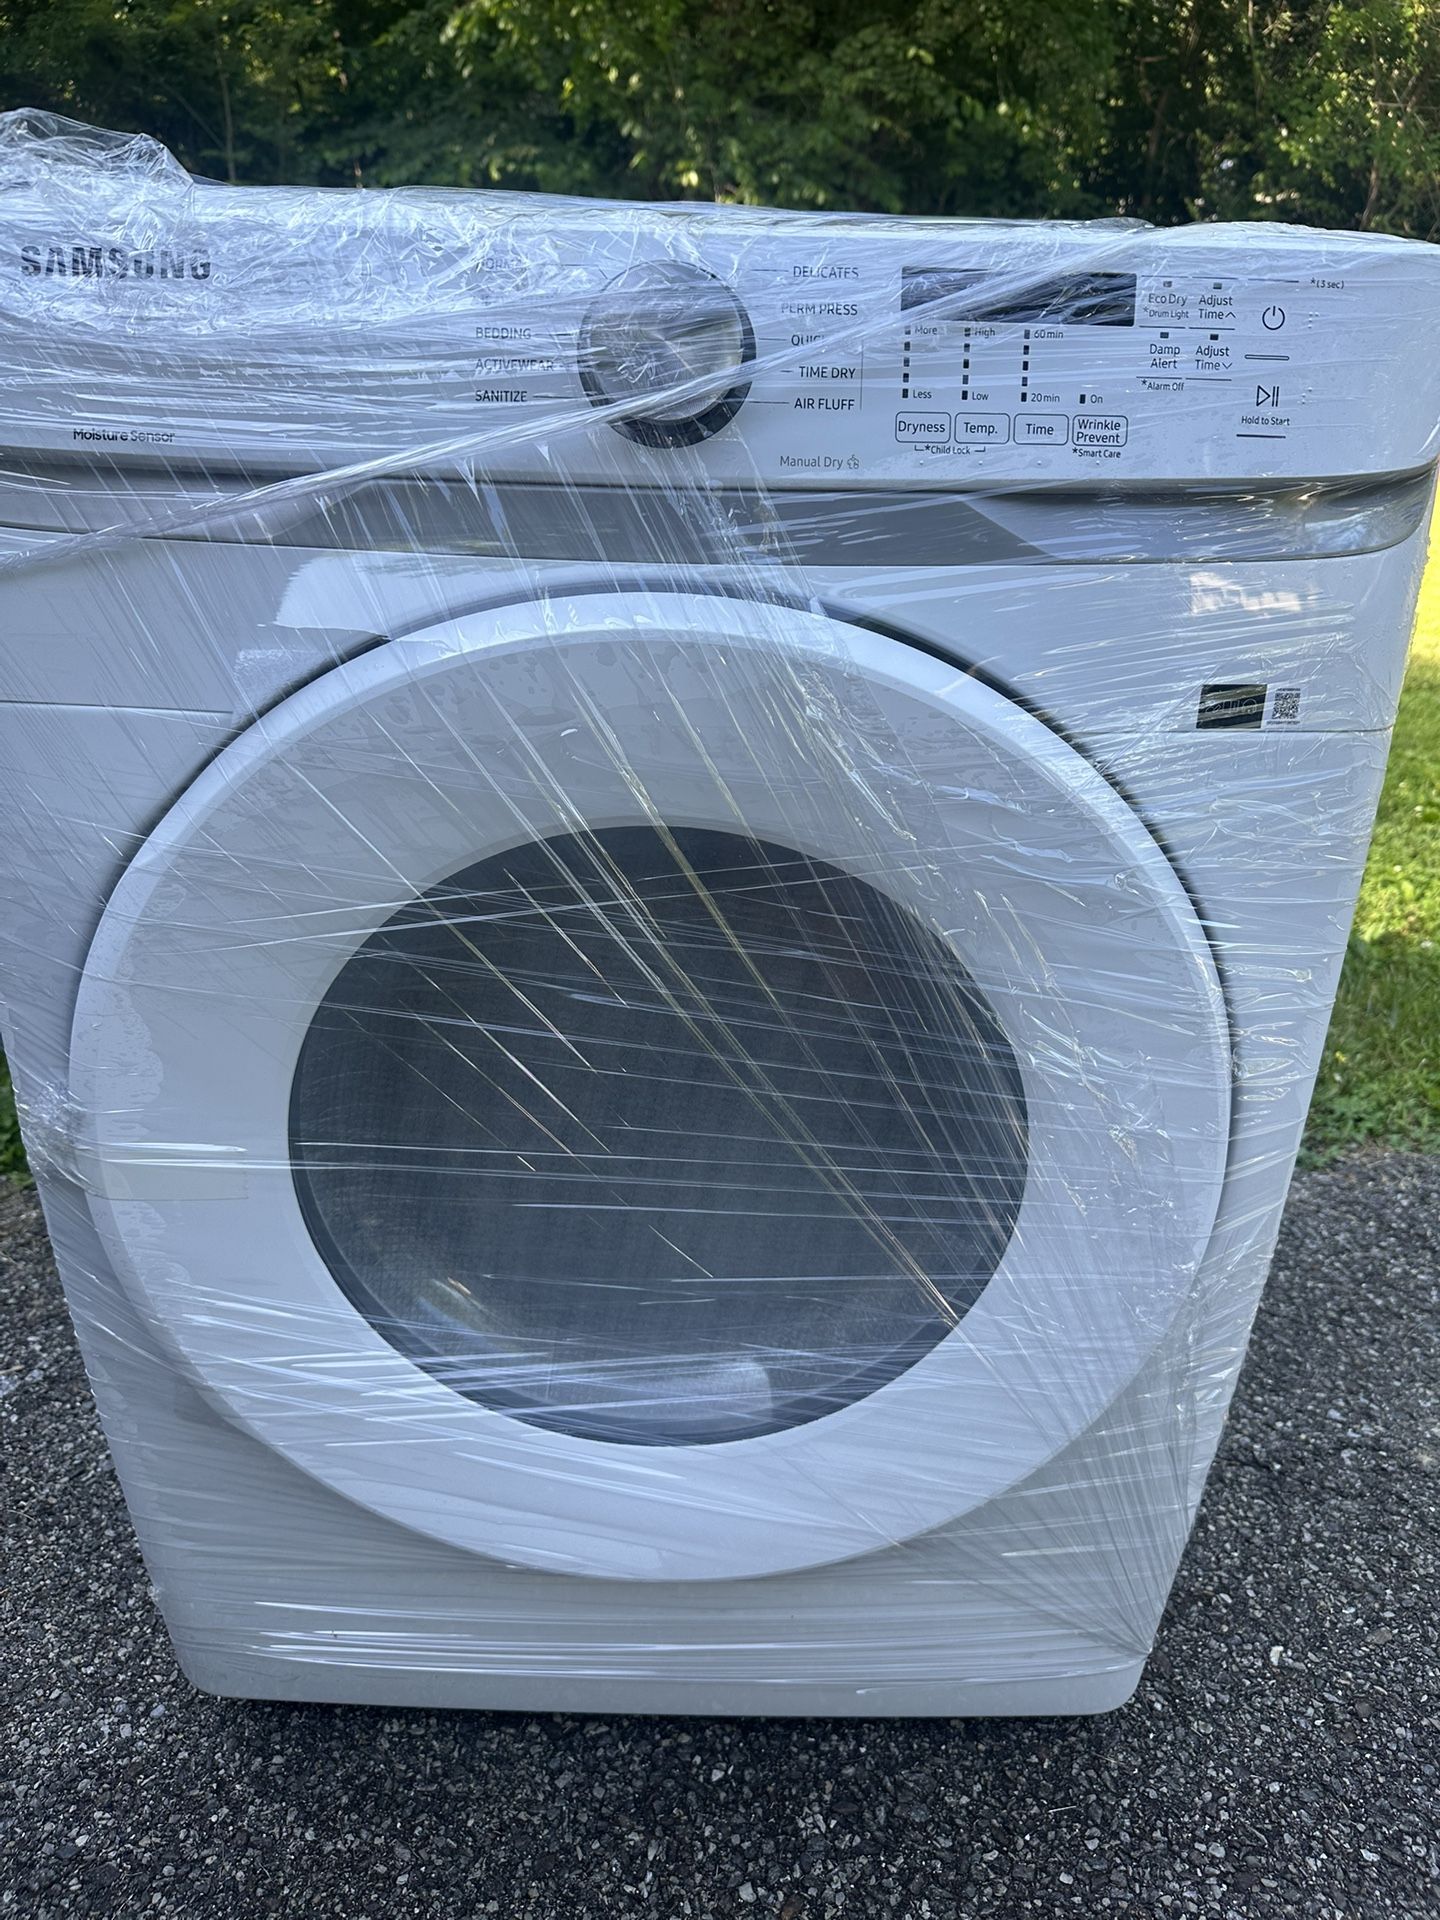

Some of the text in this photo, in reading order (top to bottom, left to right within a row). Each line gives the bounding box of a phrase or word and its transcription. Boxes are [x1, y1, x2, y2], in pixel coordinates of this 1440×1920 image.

[20, 246, 212, 280] SAMSUNG
[794, 266, 859, 279] DELICATES
[1327, 280, 1345, 289] sec)
[1148, 293, 1188, 307] Eco Dry
[1199, 295, 1233, 308] Adjust
[780, 303, 858, 316] PERM PRESS
[1171, 310, 1189, 320] Light
[1199, 309, 1224, 320] Time
[475, 327, 532, 340] BEDDING
[915, 326, 938, 336] More
[974, 327, 996, 338] High
[791, 334, 825, 347] QUIC
[1150, 343, 1180, 357] Damp
[1196, 345, 1230, 359] Adjust
[475, 358, 554, 372] ACTIVEWEAR
[1150, 359, 1178, 369] Alert
[1195, 359, 1221, 371] Time
[799, 366, 856, 380] TIME DRY
[1172, 382, 1185, 392] Off
[475, 390, 528, 403] SANITIZE
[912, 389, 932, 399] Less
[972, 391, 989, 401] Low
[1090, 394, 1104, 404] On
[794, 398, 855, 411] AIR FLUFF
[898, 420, 946, 435] Dryness
[1078, 418, 1121, 432] Wrinkle
[1241, 415, 1291, 427] Hold to Start
[964, 421, 998, 435] Temp.
[1026, 423, 1054, 436] Time
[73, 428, 176, 443] Moisture Sensor
[1076, 431, 1121, 444] Prevent
[952, 446, 971, 455] Lock
[1103, 450, 1121, 459] Care
[780, 455, 844, 470] Manual Dry
